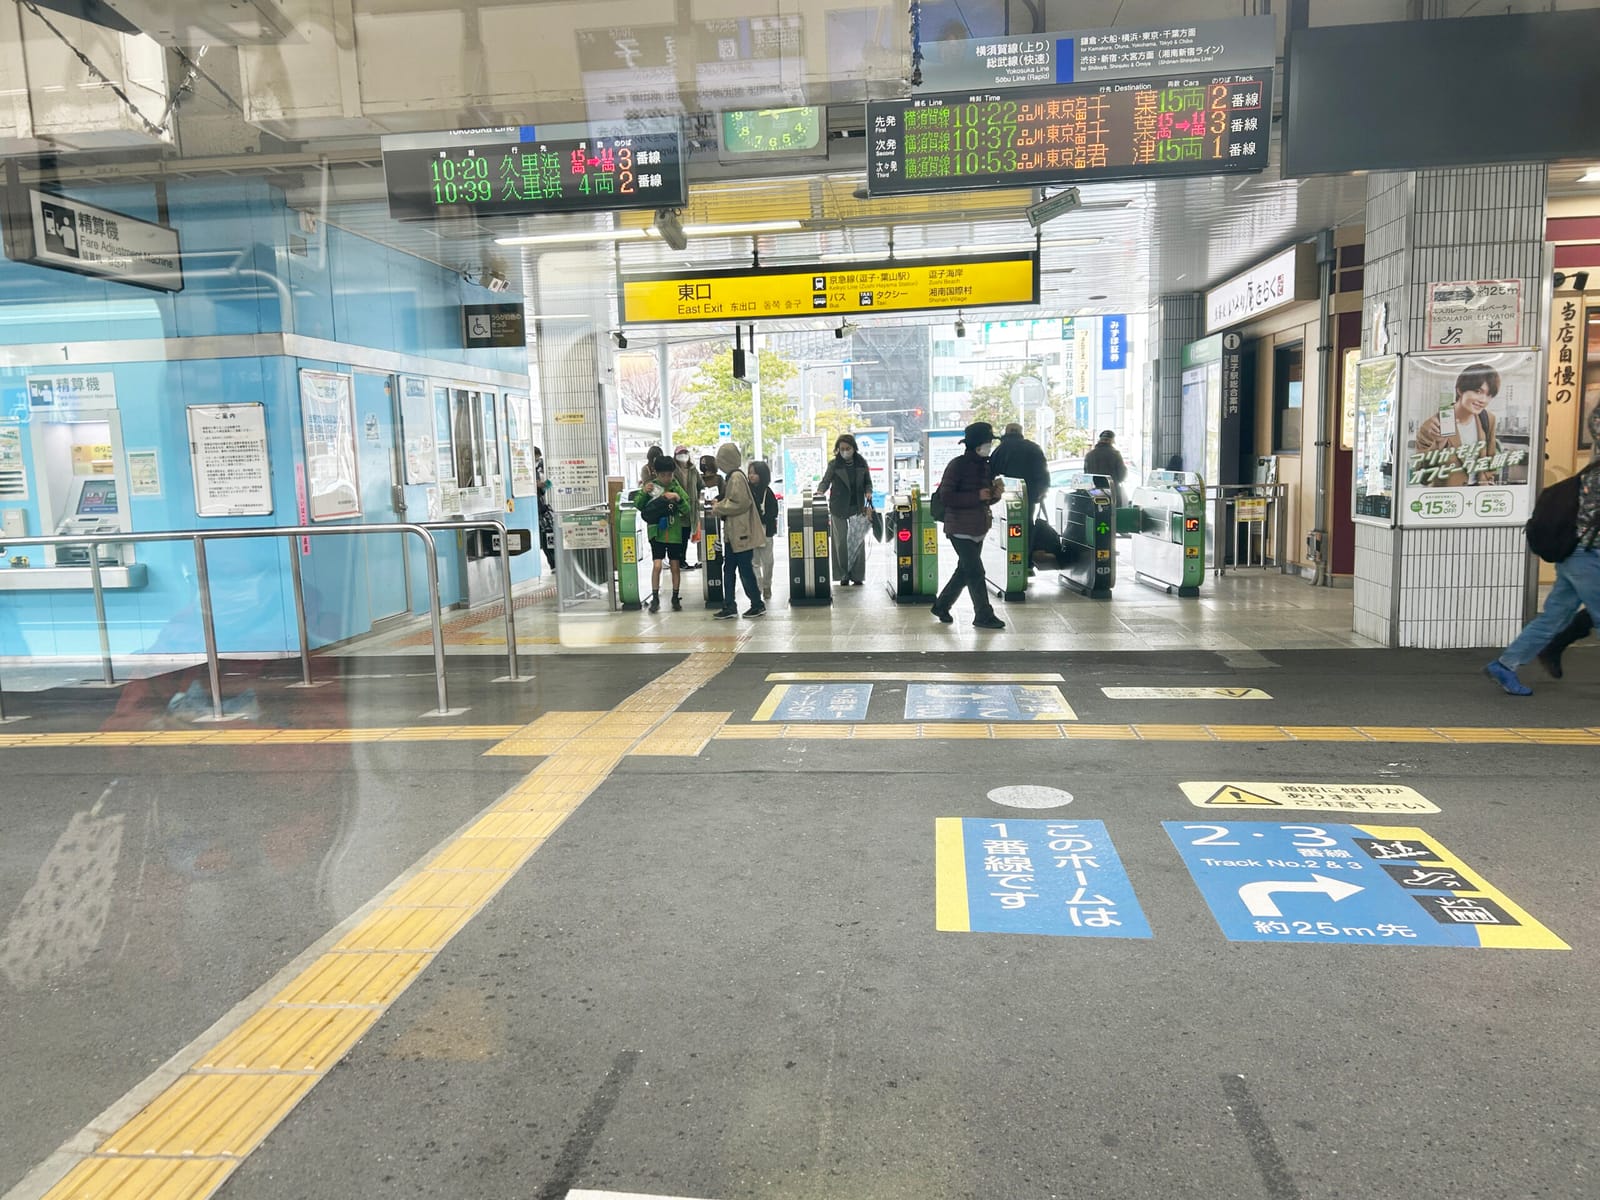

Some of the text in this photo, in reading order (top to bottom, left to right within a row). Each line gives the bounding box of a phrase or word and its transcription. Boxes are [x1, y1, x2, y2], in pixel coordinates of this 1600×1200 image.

[976, 40, 1050, 57] 横須賀線(上り)
[987, 53, 1050, 69] 総武線(快速)
[1006, 65, 1050, 75] Yokosuka Line
[1013, 74, 1026, 82] Line
[1027, 72, 1050, 82] (Rapid)
[1183, 79, 1199, 87] Cars
[1212, 74, 1254, 84] のりば Track
[1114, 83, 1152, 92] Destination
[928, 99, 942, 107] Line
[985, 94, 1000, 102] Time
[1158, 86, 1206, 113] 15両
[953, 101, 1018, 128] 10:22
[794, 122, 803, 133] 4
[875, 115, 896, 128] 先発
[741, 126, 750, 136] 8
[614, 139, 632, 147] のりば
[755, 135, 763, 145] 7
[768, 137, 777, 147] 6
[782, 133, 791, 143] 5
[953, 126, 1017, 152] 10:37
[875, 139, 897, 151] 次発
[1156, 136, 1204, 162] 15両
[431, 157, 489, 182] 10:20
[499, 152, 560, 179] 久里浜
[876, 160, 898, 173] 次々発
[953, 150, 1018, 176] 10:53
[433, 179, 492, 204] 10:39
[501, 174, 563, 201] 久里浜
[78, 211, 119, 241] 精算機
[80, 235, 99, 250] Fare
[677, 282, 711, 301] 東口
[829, 292, 847, 302] バス
[876, 290, 909, 300] タクシー
[1478, 285, 1519, 297] 約25m
[677, 303, 723, 315] East Exit
[730, 301, 757, 312] 东出口
[1477, 304, 1514, 312] エレベーター
[1433, 314, 1473, 322] ESCALATOR
[1477, 312, 1515, 321] ELEVATOR
[1109, 320, 1120, 363] みずほ証券
[61, 345, 69, 361] 1
[1553, 301, 1577, 404] 当店自慢の
[55, 376, 101, 393] 精算機
[1408, 449, 1526, 485] オフピーク定期券
[1009, 526, 1021, 537] IC
[1286, 793, 1368, 801] あります
[1296, 847, 1354, 859] 番線
[982, 823, 1040, 910] 1番線です
[1200, 858, 1260, 869] Track
[1325, 860, 1344, 870] &
[1349, 860, 1364, 871] 3
[1046, 824, 1122, 928] このホームは
[1253, 919, 1417, 939] 約25m先
